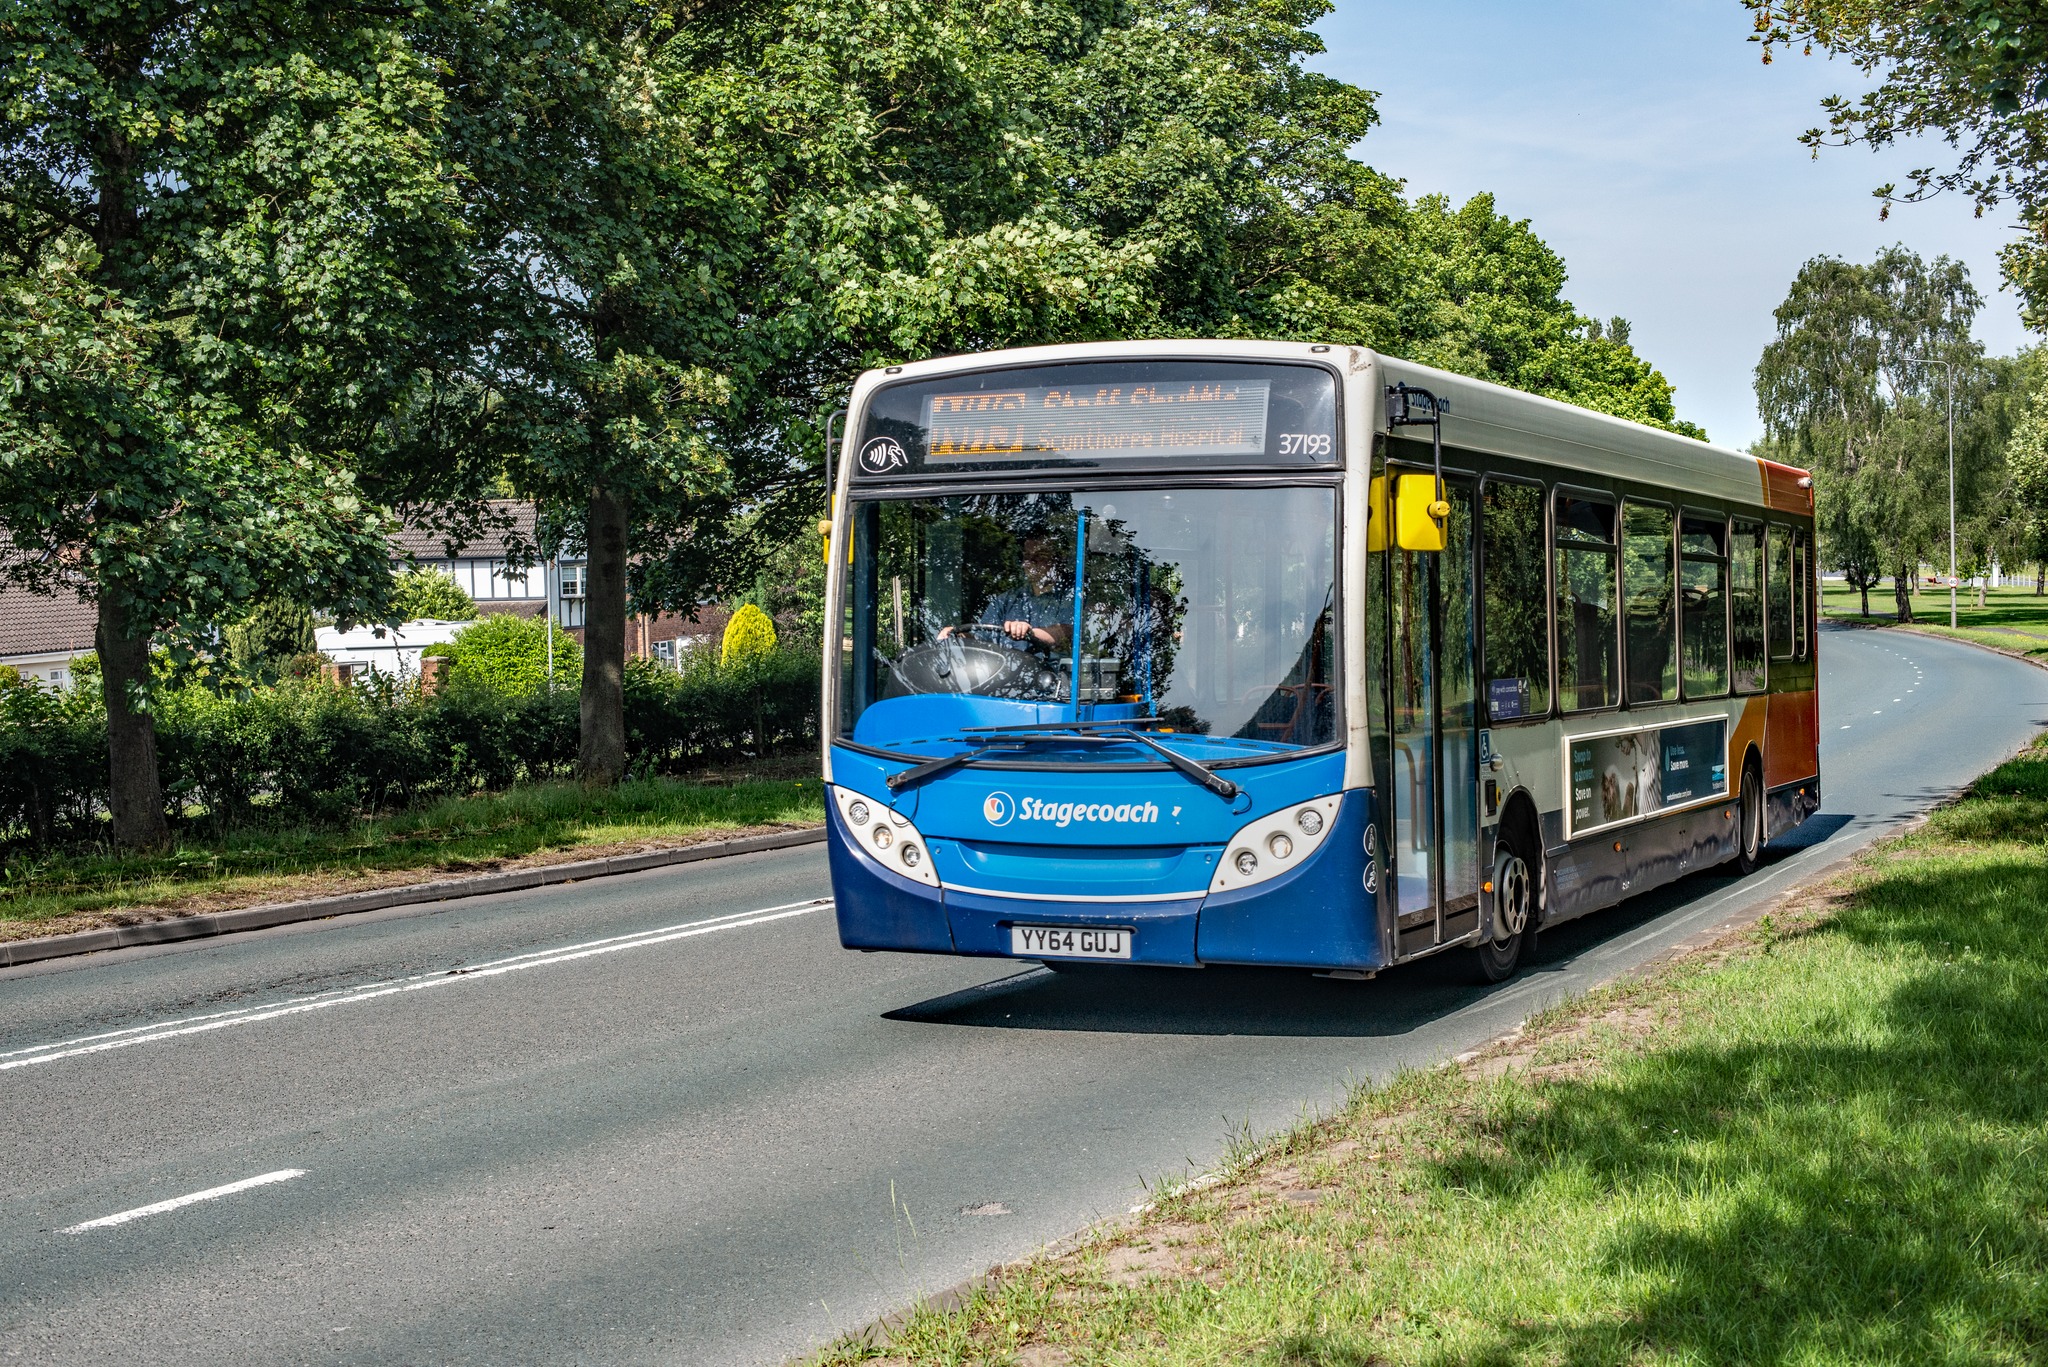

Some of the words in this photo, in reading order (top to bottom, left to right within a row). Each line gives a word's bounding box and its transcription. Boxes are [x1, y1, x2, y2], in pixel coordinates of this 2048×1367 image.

[1412, 393, 1450, 414] Stageach
[1279, 433, 1331, 455] 37193
[1575, 787, 1586, 801] Save
[1586, 787, 1592, 799] on
[1019, 797, 1159, 828] Stagecoach
[1575, 807, 1590, 825] power.
[1021, 929, 1075, 951] YY64
[1081, 931, 1121, 953] GUJ
